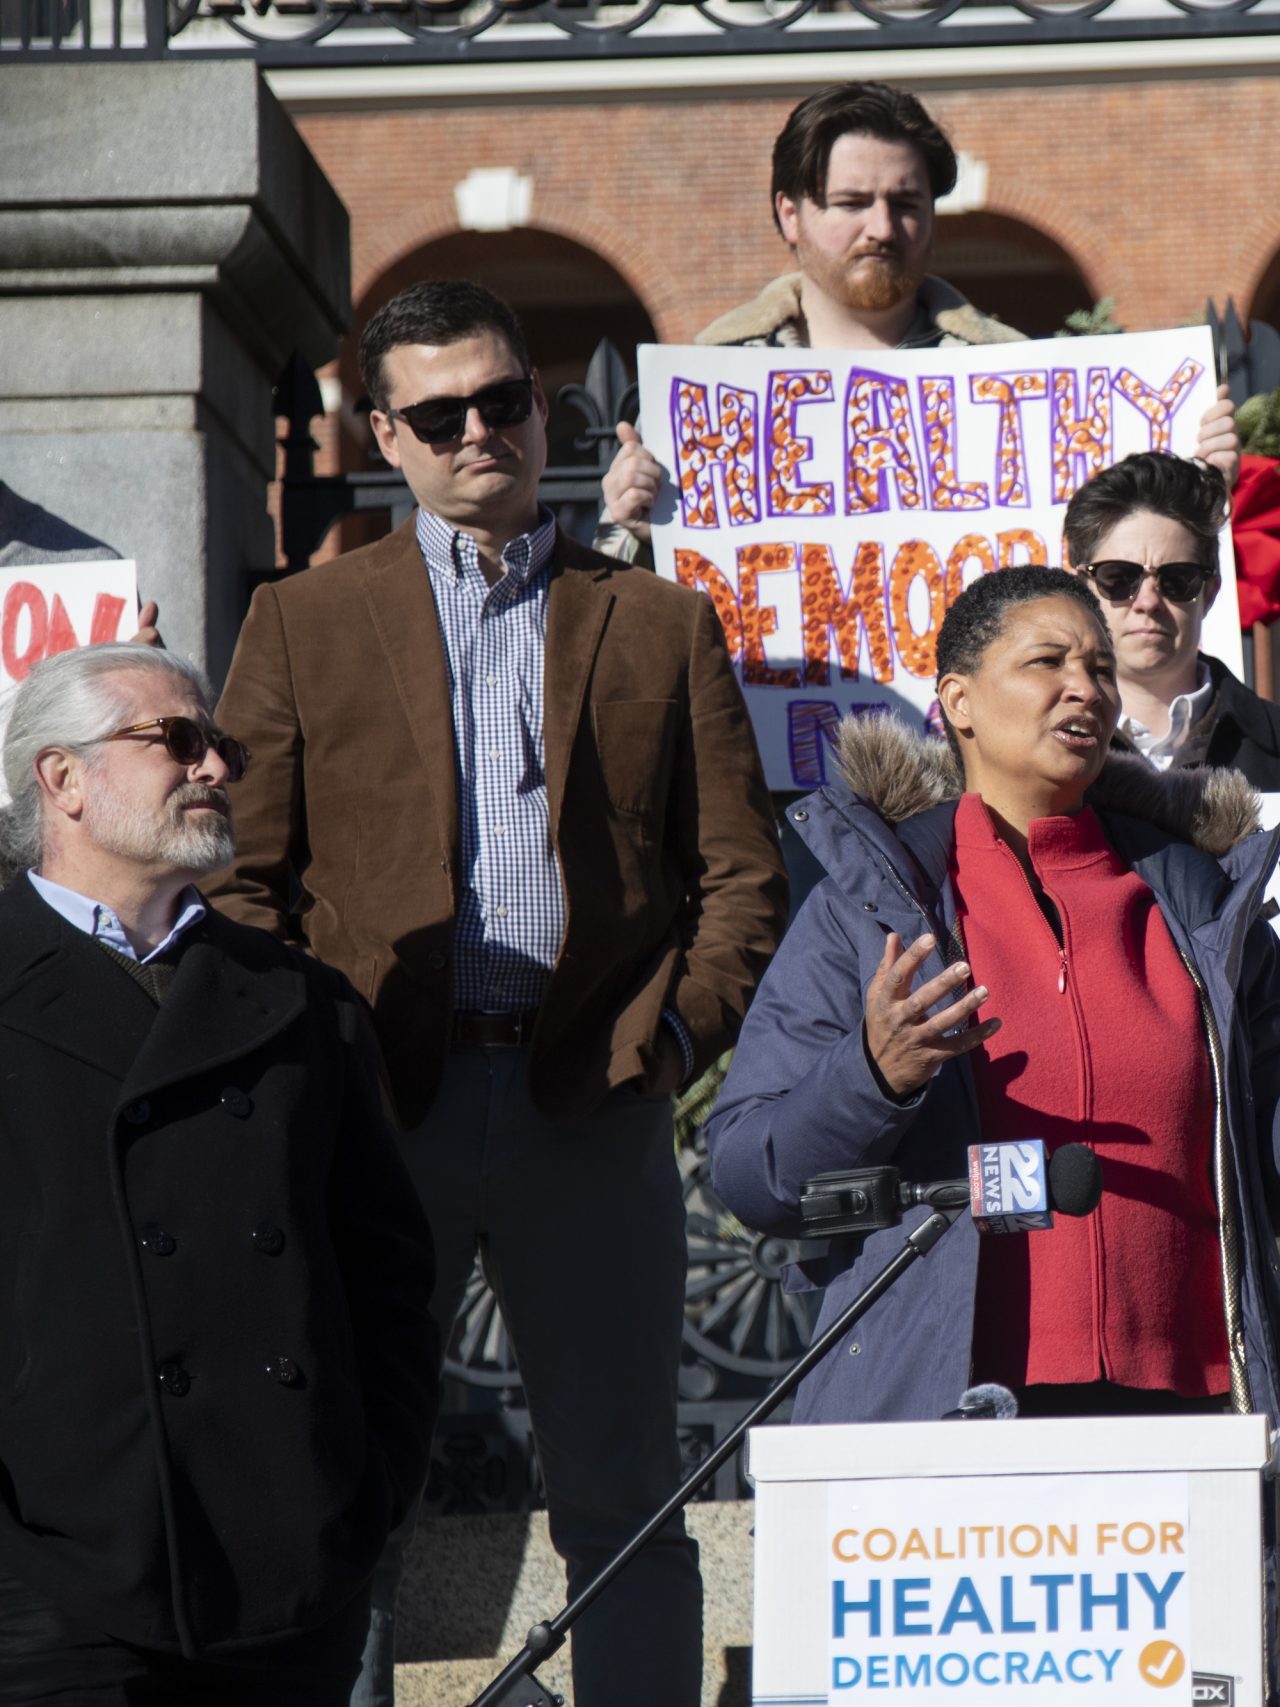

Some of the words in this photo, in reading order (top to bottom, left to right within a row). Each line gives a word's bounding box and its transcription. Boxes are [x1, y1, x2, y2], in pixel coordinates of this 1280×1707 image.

[671, 356, 1205, 529] HEALTHY
[983, 1145, 1001, 1213] NEWS
[999, 1143, 1041, 1212] 22
[833, 1525, 1079, 1562] COALITION
[1098, 1521, 1184, 1555] FOR
[832, 1570, 1185, 1639] HEALTHY
[832, 1648, 1123, 1690] DEMOCRACY
[1192, 1684, 1225, 1700] OX
